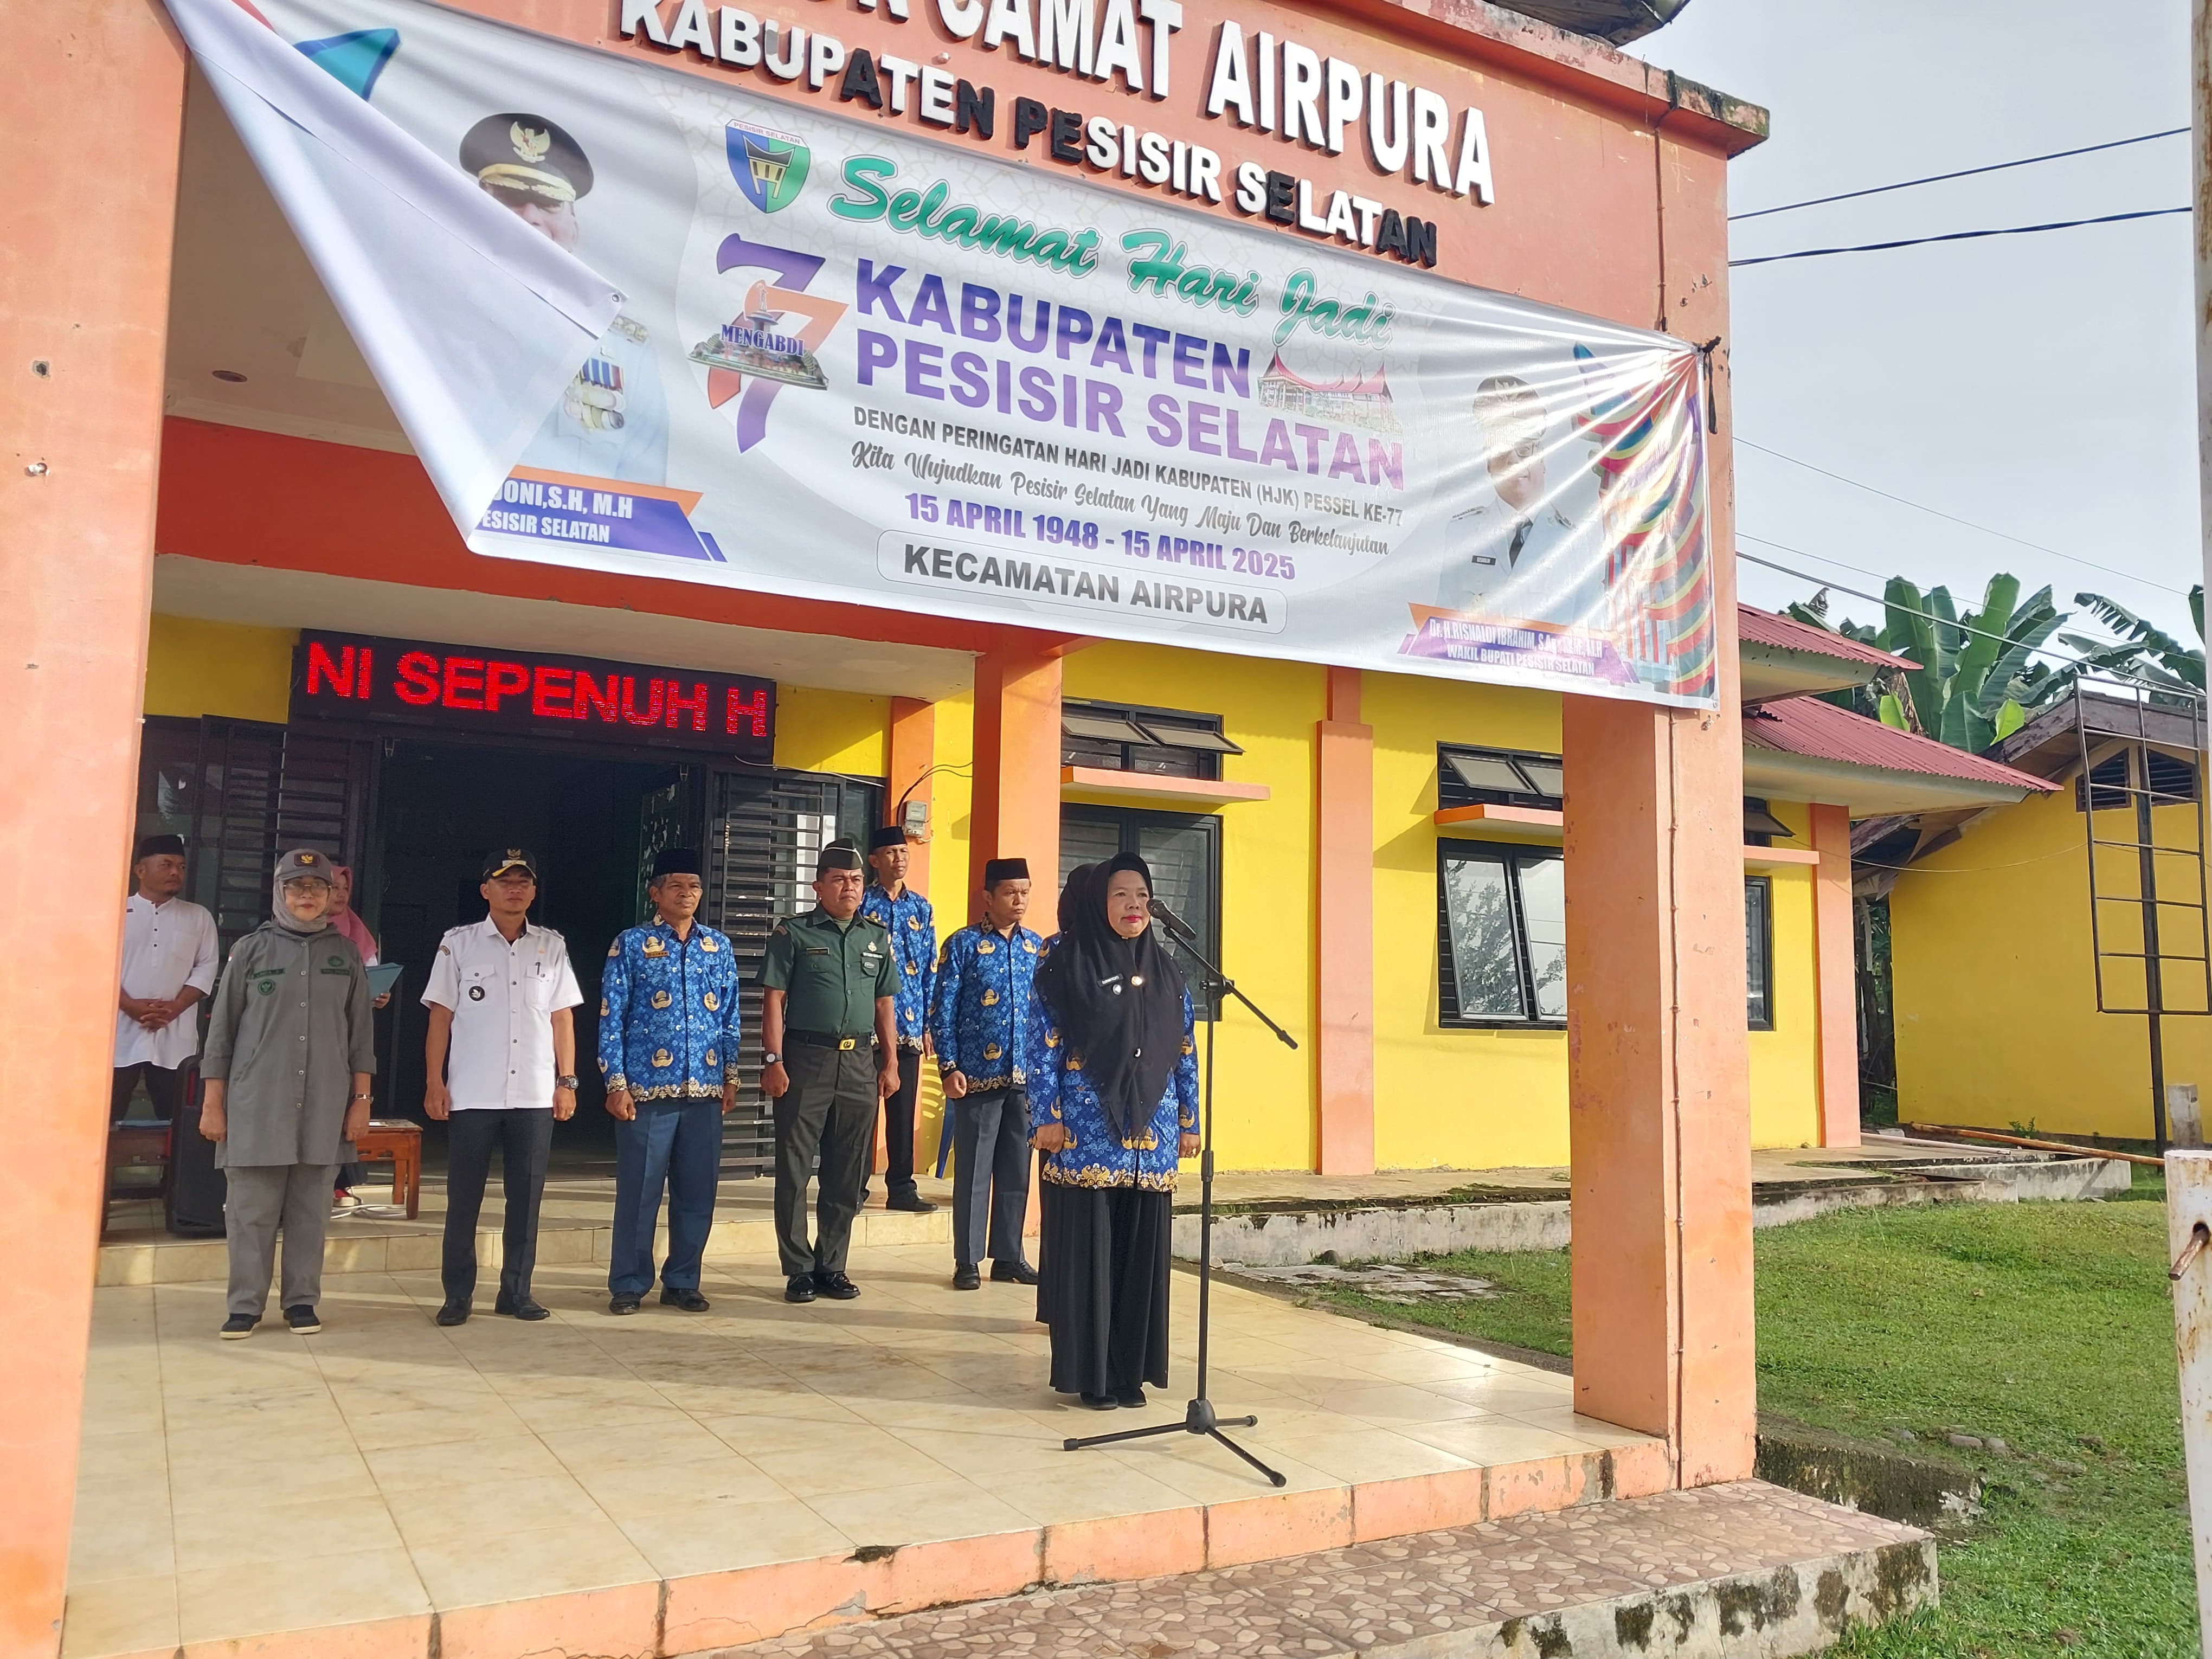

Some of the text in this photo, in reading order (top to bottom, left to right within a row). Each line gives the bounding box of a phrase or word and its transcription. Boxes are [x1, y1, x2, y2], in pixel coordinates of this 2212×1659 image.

[620, 0, 1437, 268] KABUPATEN PESISIR SELATAN
[734, 122, 801, 144] PESISIR SELATAN
[1205, 19, 1495, 207] AIRPURA
[828, 156, 1395, 349] Selamat Hari Jadi
[721, 324, 805, 357] MENGABDI
[857, 258, 1250, 399] KABUPATEN
[857, 329, 1404, 491] PESISIR SELATAN
[593, 492, 633, 519] M.H
[852, 441, 1389, 556] Kita Wujudkan Pesisir Selatan Yang Maju Dan Berkelanjutan
[854, 406, 1403, 526] DENGAN PERINGATAN HARI JADI KABUPATEN (HJK) PESSEL KE-77
[541, 517, 610, 543] SELATAN
[905, 493, 939, 523] 15
[947, 499, 1026, 538] APRIL
[1033, 515, 1099, 549] 1948
[1121, 529, 1150, 559] 15
[1156, 534, 1226, 570] APRIL
[1232, 546, 1295, 580] 2025
[904, 543, 1268, 624] KECAMATAN AIRPURA
[307, 642, 767, 737] NI SEPENUH H
[1447, 644, 1594, 676] WAKIL BUPATI PESISIR SELATAN
